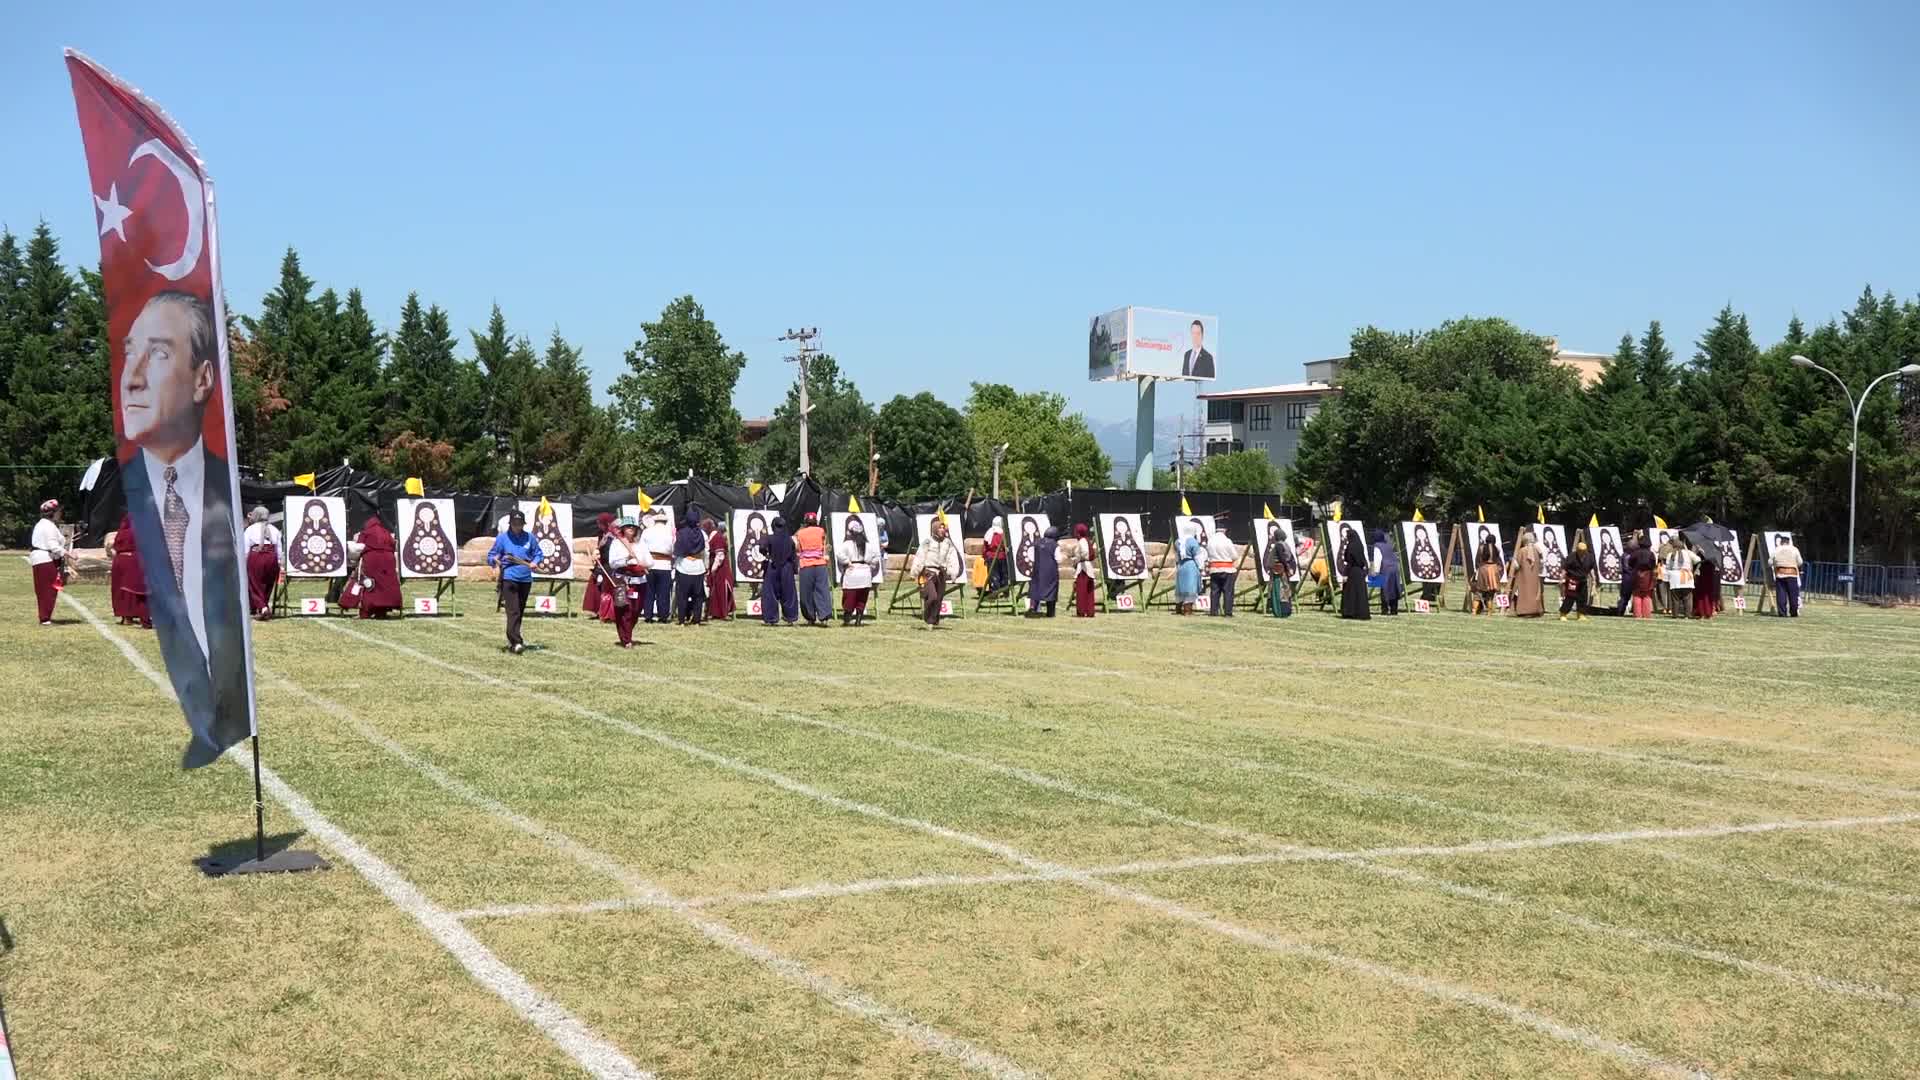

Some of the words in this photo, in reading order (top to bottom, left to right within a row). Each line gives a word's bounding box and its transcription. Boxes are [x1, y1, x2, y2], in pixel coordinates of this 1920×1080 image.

[308, 600, 318, 612] 2
[421, 599, 431, 612] 3
[541, 598, 551, 609] 4
[1118, 595, 1132, 607] 10
[1198, 598, 1209, 608] 11
[1417, 601, 1428, 611] 14
[1497, 595, 1508, 606] 15
[752, 602, 761, 613] 6
